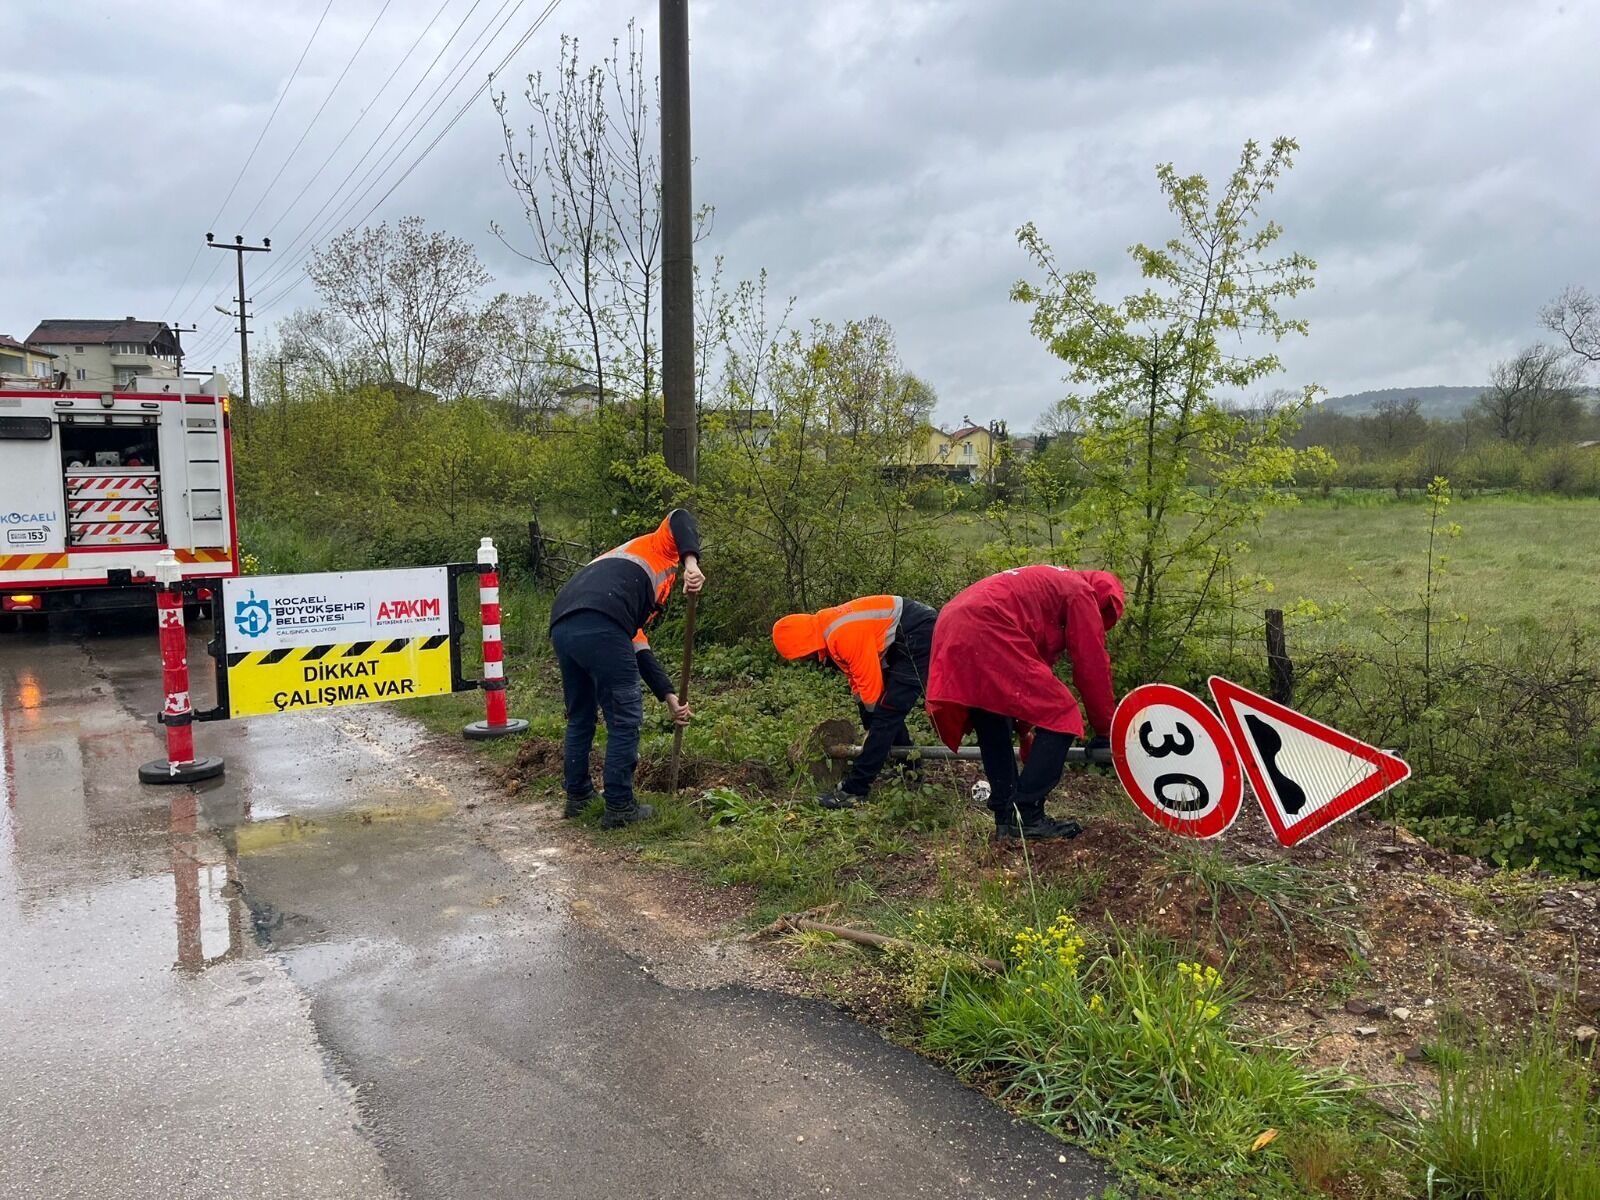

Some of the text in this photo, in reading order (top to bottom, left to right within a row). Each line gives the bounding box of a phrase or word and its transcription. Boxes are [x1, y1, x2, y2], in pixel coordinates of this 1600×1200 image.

[28, 532, 43, 540] 153
[275, 596, 327, 606] KOCAELİ
[275, 602, 365, 616] BÜYÜKŞEHİR
[377, 598, 440, 620] A-TAKIMI
[276, 613, 345, 625] BELEDİYESİ
[303, 660, 380, 683] DİKKAT
[273, 678, 414, 711] ÇALIŞMA VAR
[1138, 720, 1210, 812] 30
